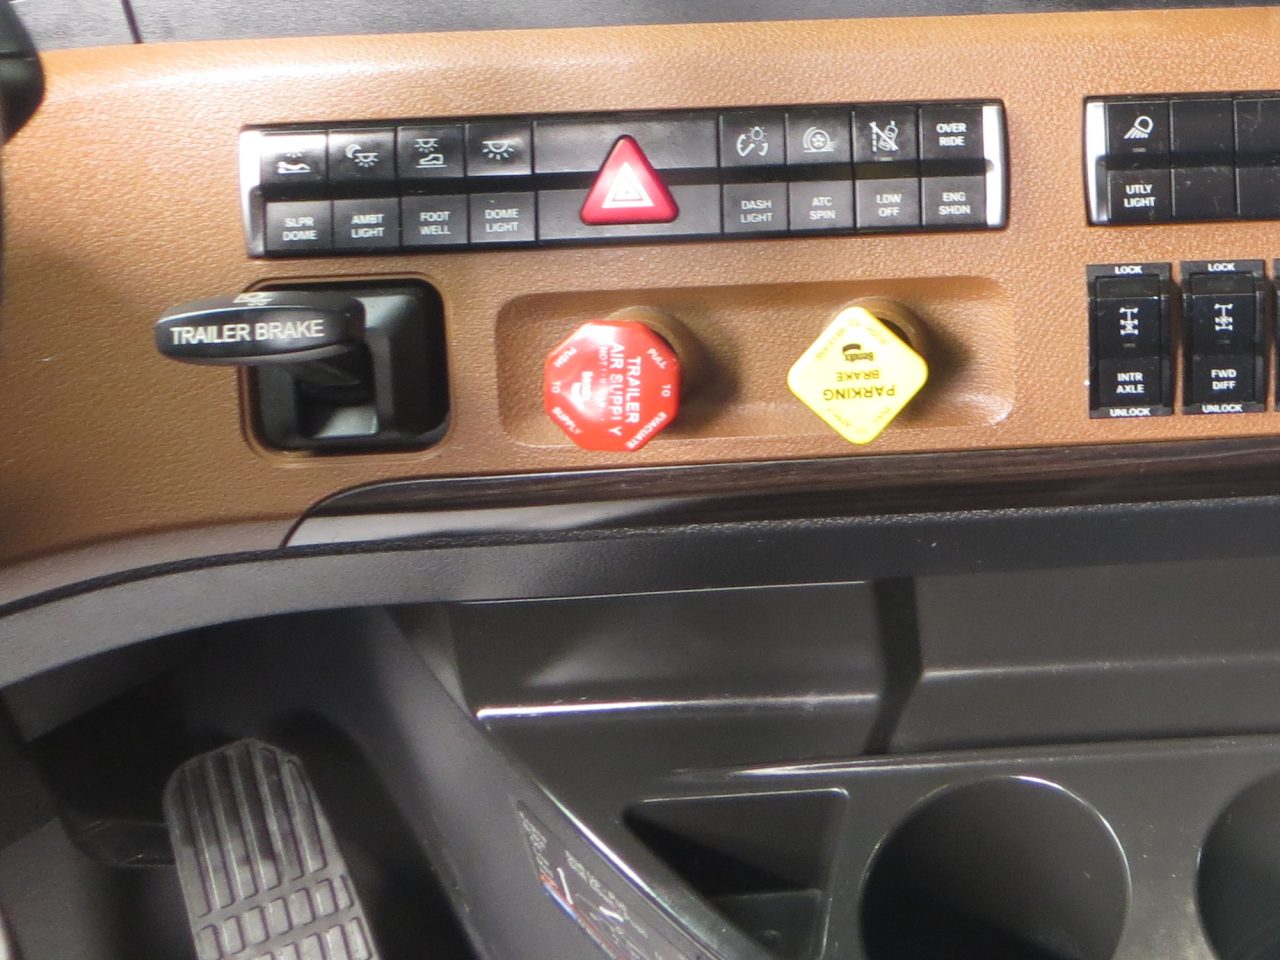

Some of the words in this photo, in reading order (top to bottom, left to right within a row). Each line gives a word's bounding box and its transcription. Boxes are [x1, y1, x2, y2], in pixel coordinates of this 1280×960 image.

[936, 122, 967, 134] OVER
[938, 135, 966, 147] RIDE
[1125, 183, 1153, 195] UTLY
[810, 196, 833, 207] ATC
[875, 192, 903, 205] LDW
[942, 191, 967, 203] ENG
[1124, 196, 1156, 208] LIGHT
[740, 198, 773, 210] DASH
[938, 203, 972, 216] SHDN
[419, 210, 451, 223] FOOT
[484, 207, 520, 220] DOME
[809, 209, 837, 221] SPIN
[877, 205, 901, 218] OFF
[283, 216, 315, 228] SLPR
[350, 213, 385, 226] AMBT
[740, 212, 774, 224] LIGHT
[350, 226, 385, 239] LIGHT
[419, 224, 452, 236] WELL
[485, 221, 520, 234] LIGHT
[282, 229, 318, 242] DOME
[1114, 265, 1143, 275] LOCK
[1207, 262, 1236, 272] LOCK
[170, 324, 251, 344] TRAILER
[255, 320, 325, 340] BRAKE
[609, 342, 625, 369] AIR
[836, 369, 880, 382] BRAKE
[1116, 371, 1144, 382] INTR
[1210, 368, 1238, 379] FWD
[625, 355, 642, 424] TRAILER
[661, 383, 672, 398] TO
[1115, 383, 1145, 395] AXLE
[1211, 380, 1237, 390] DIFF
[822, 385, 896, 401] PARKING
[1109, 407, 1152, 417] UNLOCK
[1201, 403, 1244, 413] UNLOCK
